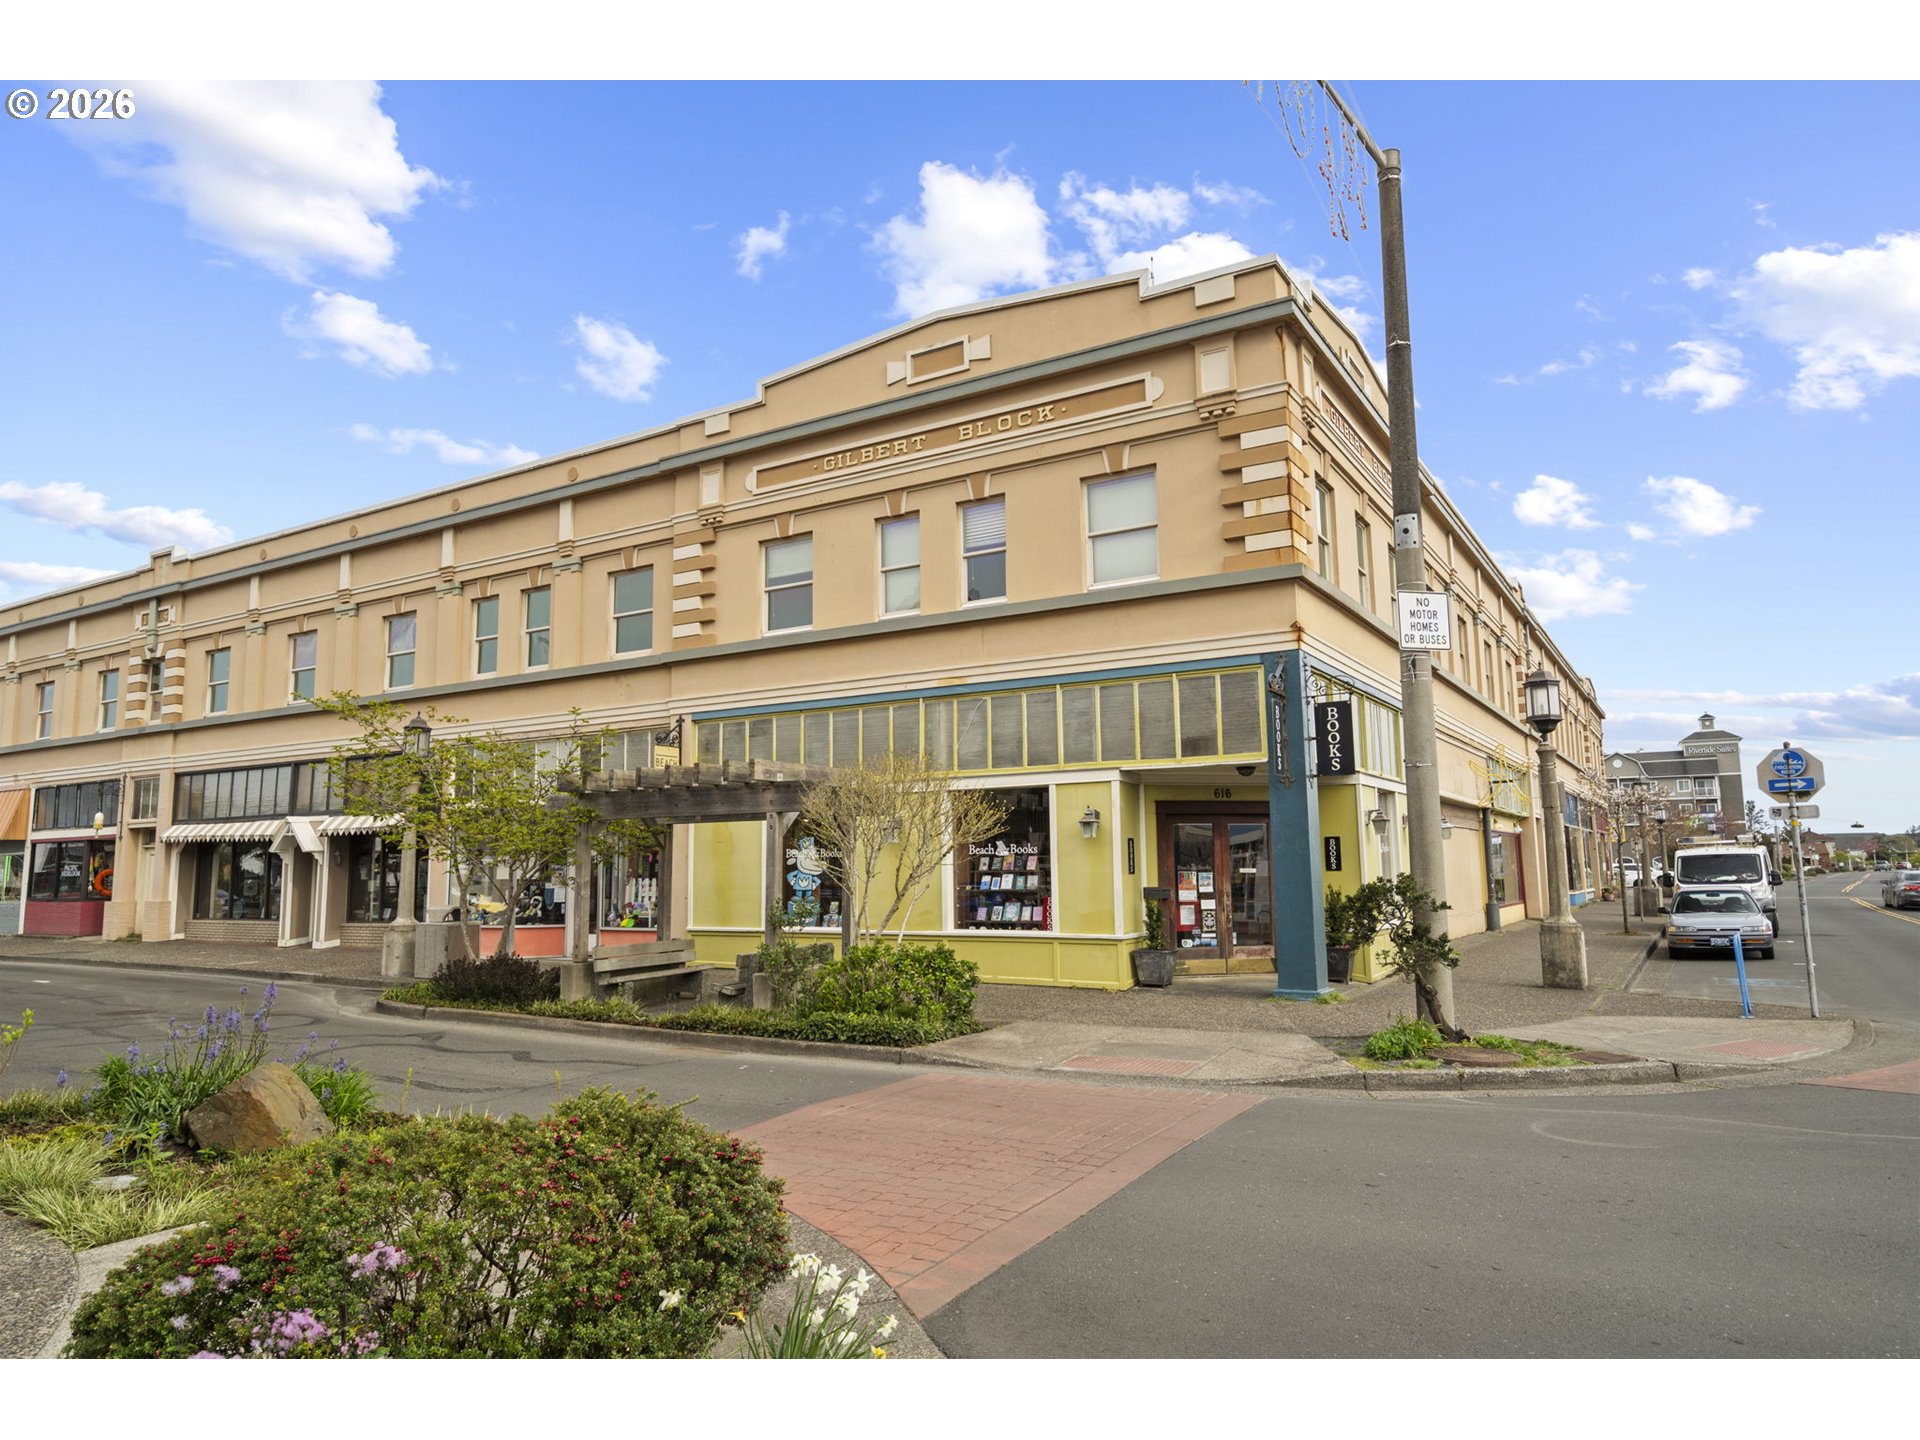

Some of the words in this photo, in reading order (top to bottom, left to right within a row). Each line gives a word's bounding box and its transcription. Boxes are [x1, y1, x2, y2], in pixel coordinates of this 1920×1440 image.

[823, 435, 927, 472] GILBERT
[958, 404, 1056, 441] BLOCK
[1416, 597, 1430, 607] NO
[1409, 609, 1438, 620] MOTOR
[1410, 621, 1439, 632] HOMES
[1404, 633, 1416, 643] OR
[1419, 634, 1447, 645] BUSES
[1326, 706, 1342, 771] BOOKS
[1214, 787, 1232, 799] 616
[820, 847, 843, 858] Books
[968, 843, 995, 855] Beach
[1010, 842, 1038, 854] Books
[1329, 838, 1337, 870] BOOKS
